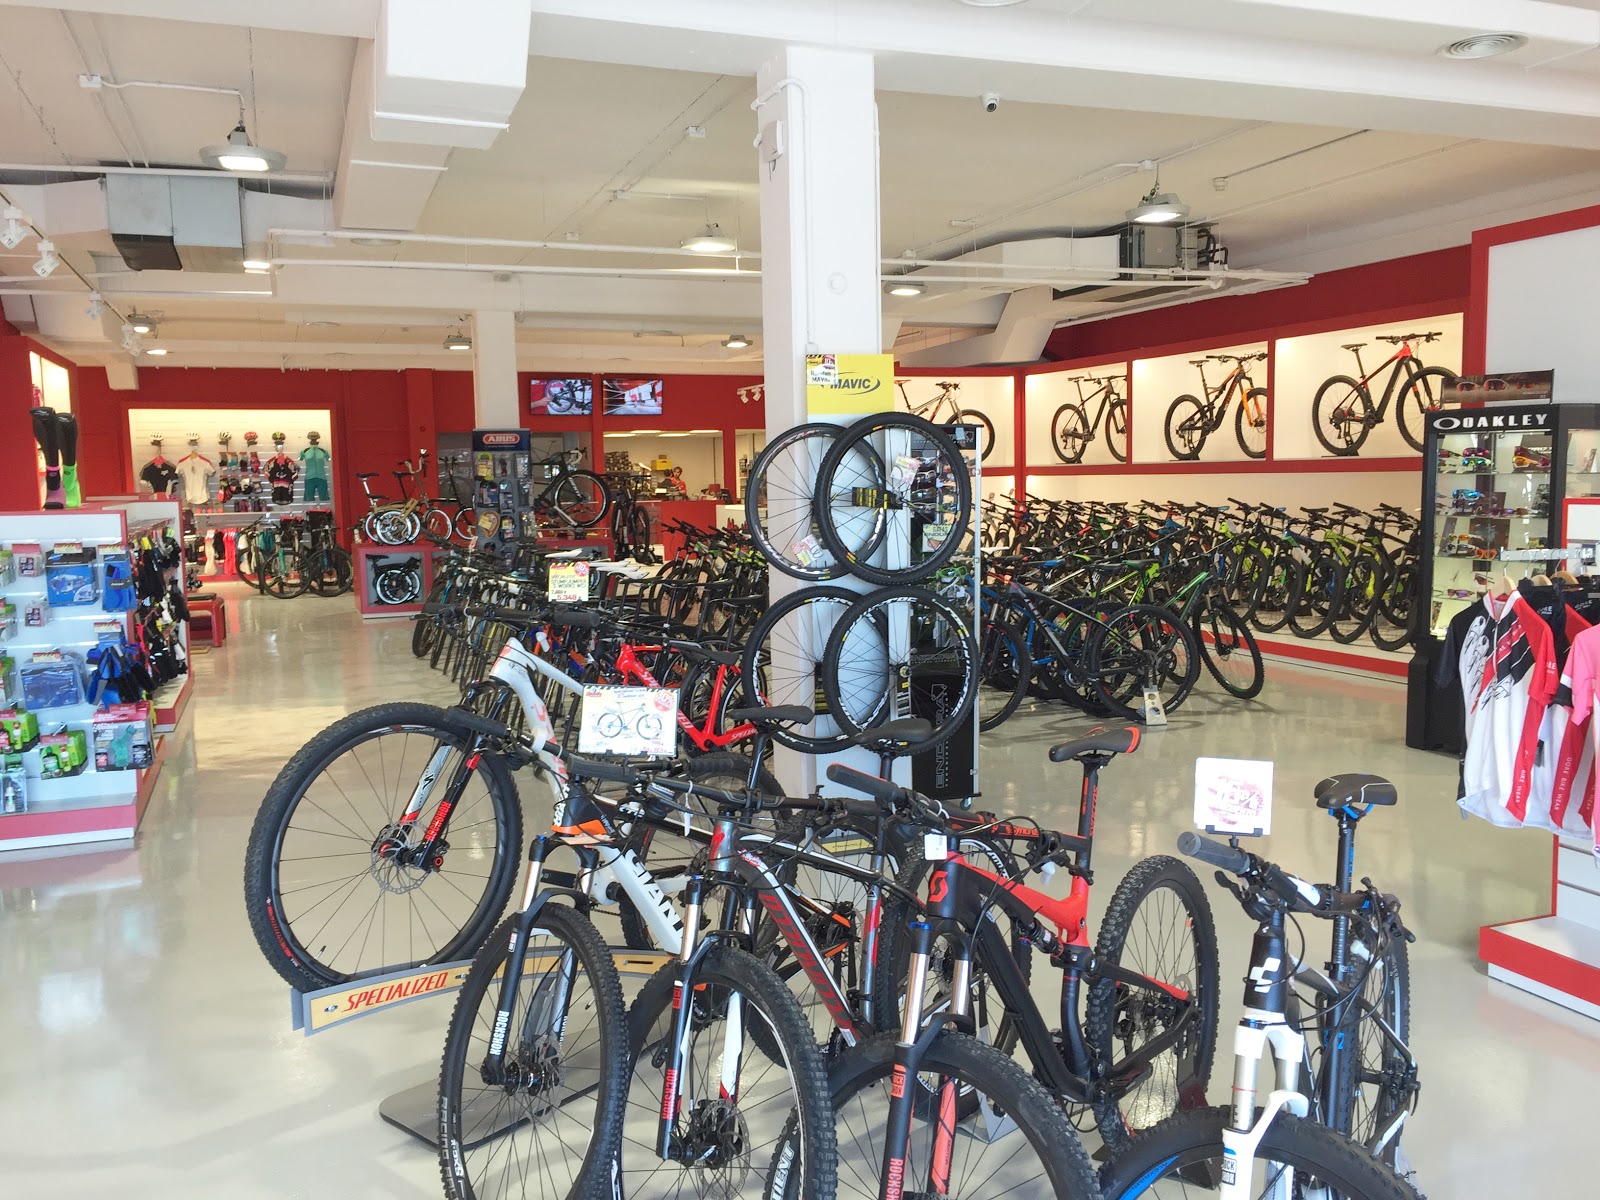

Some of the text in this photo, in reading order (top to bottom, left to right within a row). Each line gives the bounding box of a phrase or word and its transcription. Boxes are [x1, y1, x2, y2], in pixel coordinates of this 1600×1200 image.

[830, 378, 871, 389] MAVIC
[1462, 413, 1548, 428] OAKLEY
[936, 693, 944, 788] ENDRA
[424, 801, 452, 842] ROCKSHOX
[341, 972, 449, 1013] SPECIALIZED
[490, 1010, 509, 1056] ROCKSHOX
[662, 1069, 678, 1120] ROCKSHOX
[886, 1158, 903, 1200] ROCKSH
